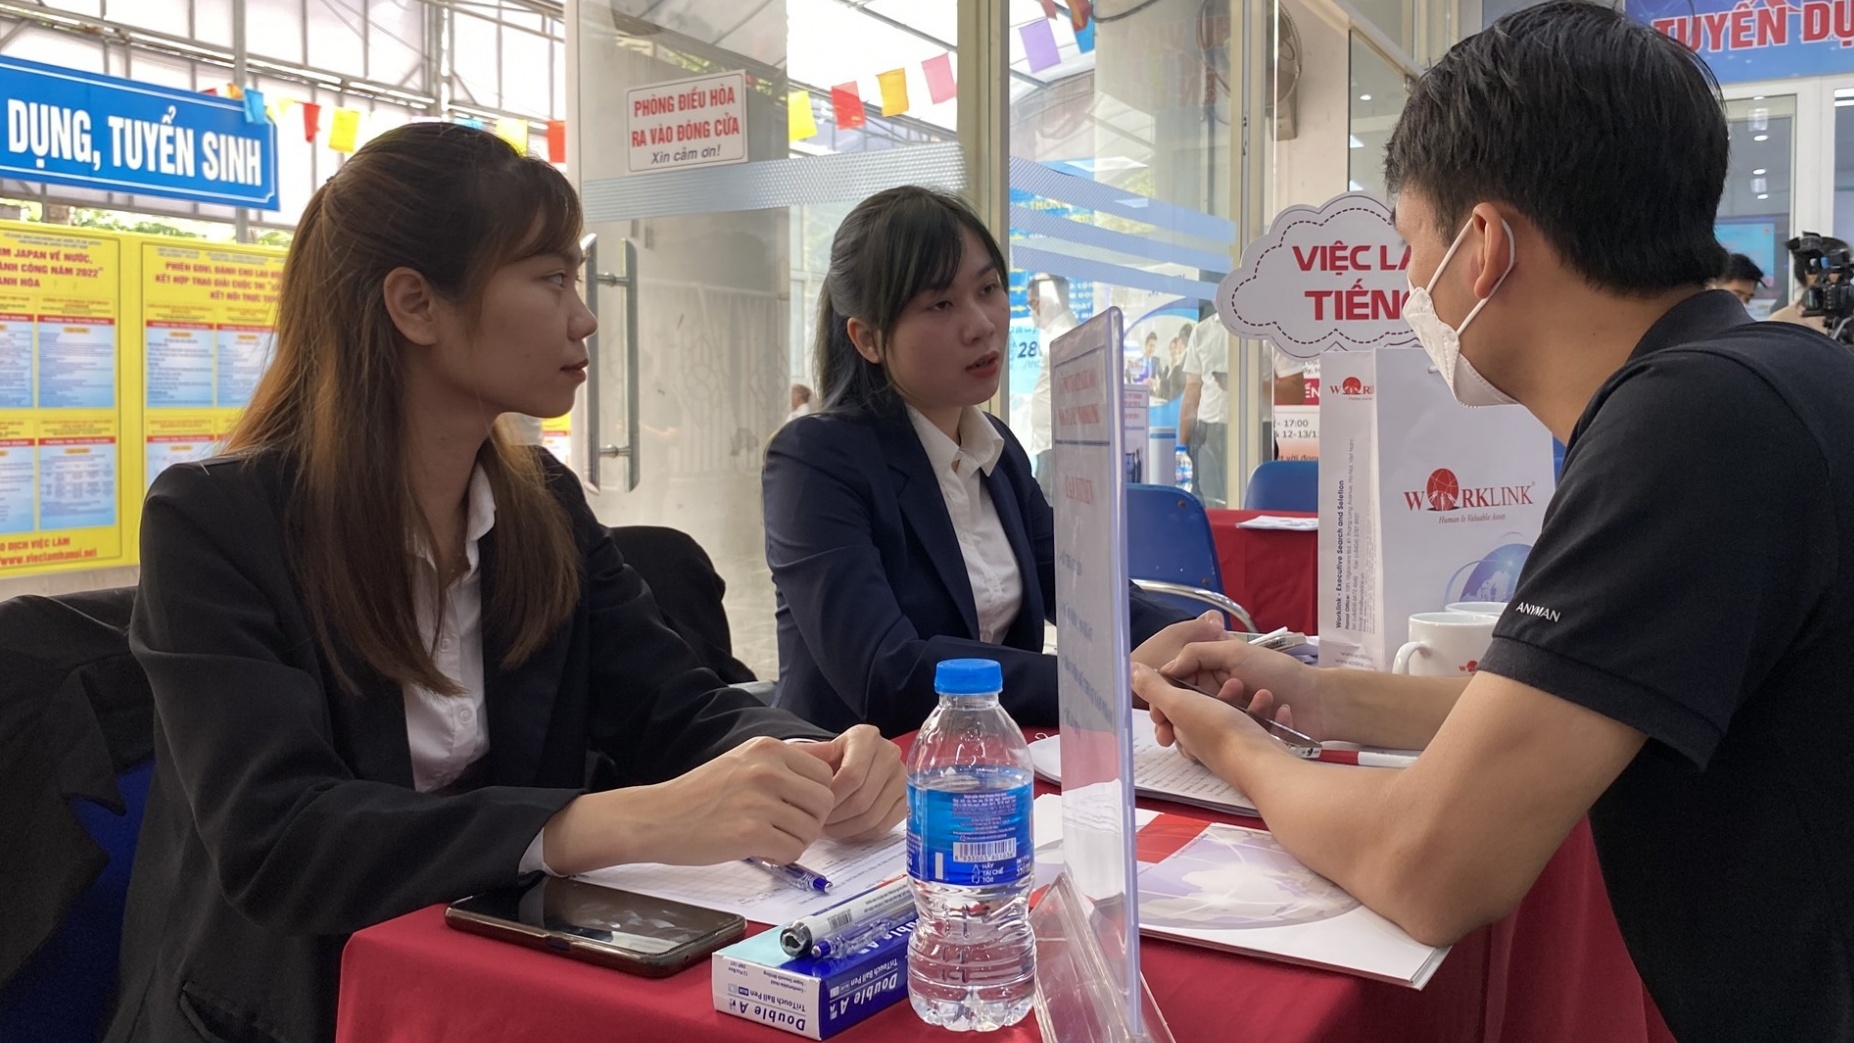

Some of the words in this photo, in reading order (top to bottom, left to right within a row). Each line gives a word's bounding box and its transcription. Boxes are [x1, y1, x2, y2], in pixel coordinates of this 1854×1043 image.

[634, 94, 675, 118] PHÒNG
[678, 86, 706, 112] ĐIỀU
[710, 83, 735, 107] HÒA
[631, 130, 647, 148] RA
[650, 124, 674, 145] VÀO
[677, 119, 711, 142] ĐÓNG
[714, 112, 740, 137] CỬA
[8, 98, 101, 171] DỤNG,
[108, 105, 195, 177] TUYỂN
[202, 131, 262, 186] SINH
[651, 150, 670, 164] Xin
[674, 147, 698, 161] cảm
[701, 144, 721, 158] ơn!
[1292, 240, 1372, 276] VIỆC
[1304, 278, 1411, 320] TIẾN
[1017, 341, 1038, 359] 28
[1284, 419, 1309, 427] 17:00
[1404, 468, 1533, 512] WORKLINK
[1438, 515, 1460, 525] Human
[1467, 513, 1490, 522] Valuable
[1335, 555, 1343, 592] Executive
[1516, 602, 1561, 622] ANYMAN
[862, 969, 873, 981] Ball
[874, 958, 898, 976] TriTouch
[850, 975, 862, 986] Pen
[853, 972, 898, 1005] Double
[749, 989, 762, 999] Pen
[762, 993, 776, 1003] Ball
[739, 1001, 749, 1014] A
[776, 997, 806, 1012] TriTouch
[840, 997, 850, 1015] A
[753, 1005, 806, 1031] Double
